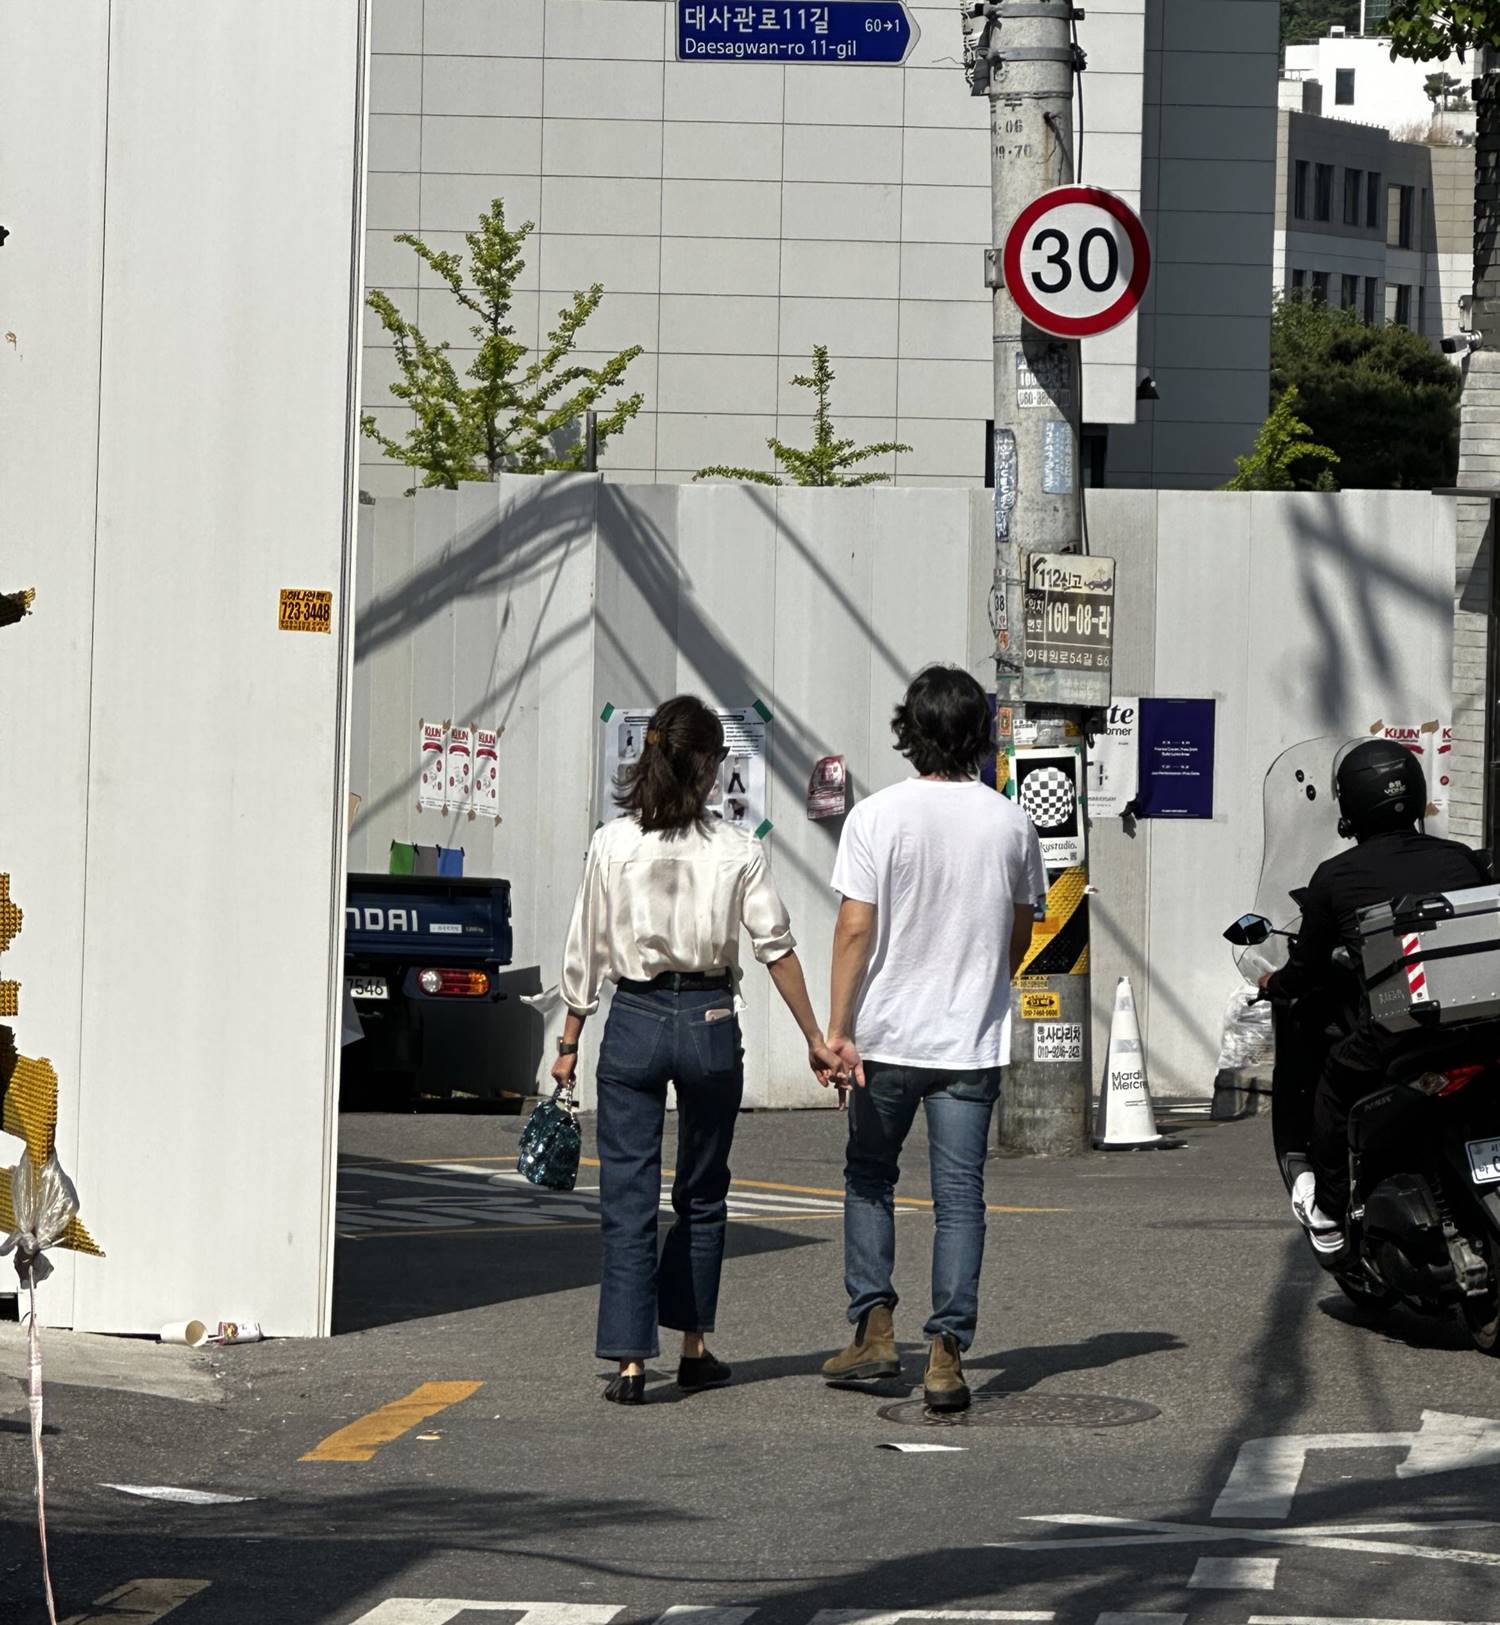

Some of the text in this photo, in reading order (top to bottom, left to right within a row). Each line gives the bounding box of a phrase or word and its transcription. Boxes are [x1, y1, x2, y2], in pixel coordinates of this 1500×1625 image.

[685, 5, 829, 34] 대사관로11길
[685, 38, 857, 59] Daesagwan-ro 11-gil
[1030, 227, 1119, 293] 30
[1039, 568, 1083, 591] 112신고
[281, 601, 330, 621] 723-3448
[1026, 648, 1093, 666] 이태원로54길
[1109, 704, 1134, 724] te
[1106, 727, 1132, 736] orner
[345, 907, 419, 932] NDAI
